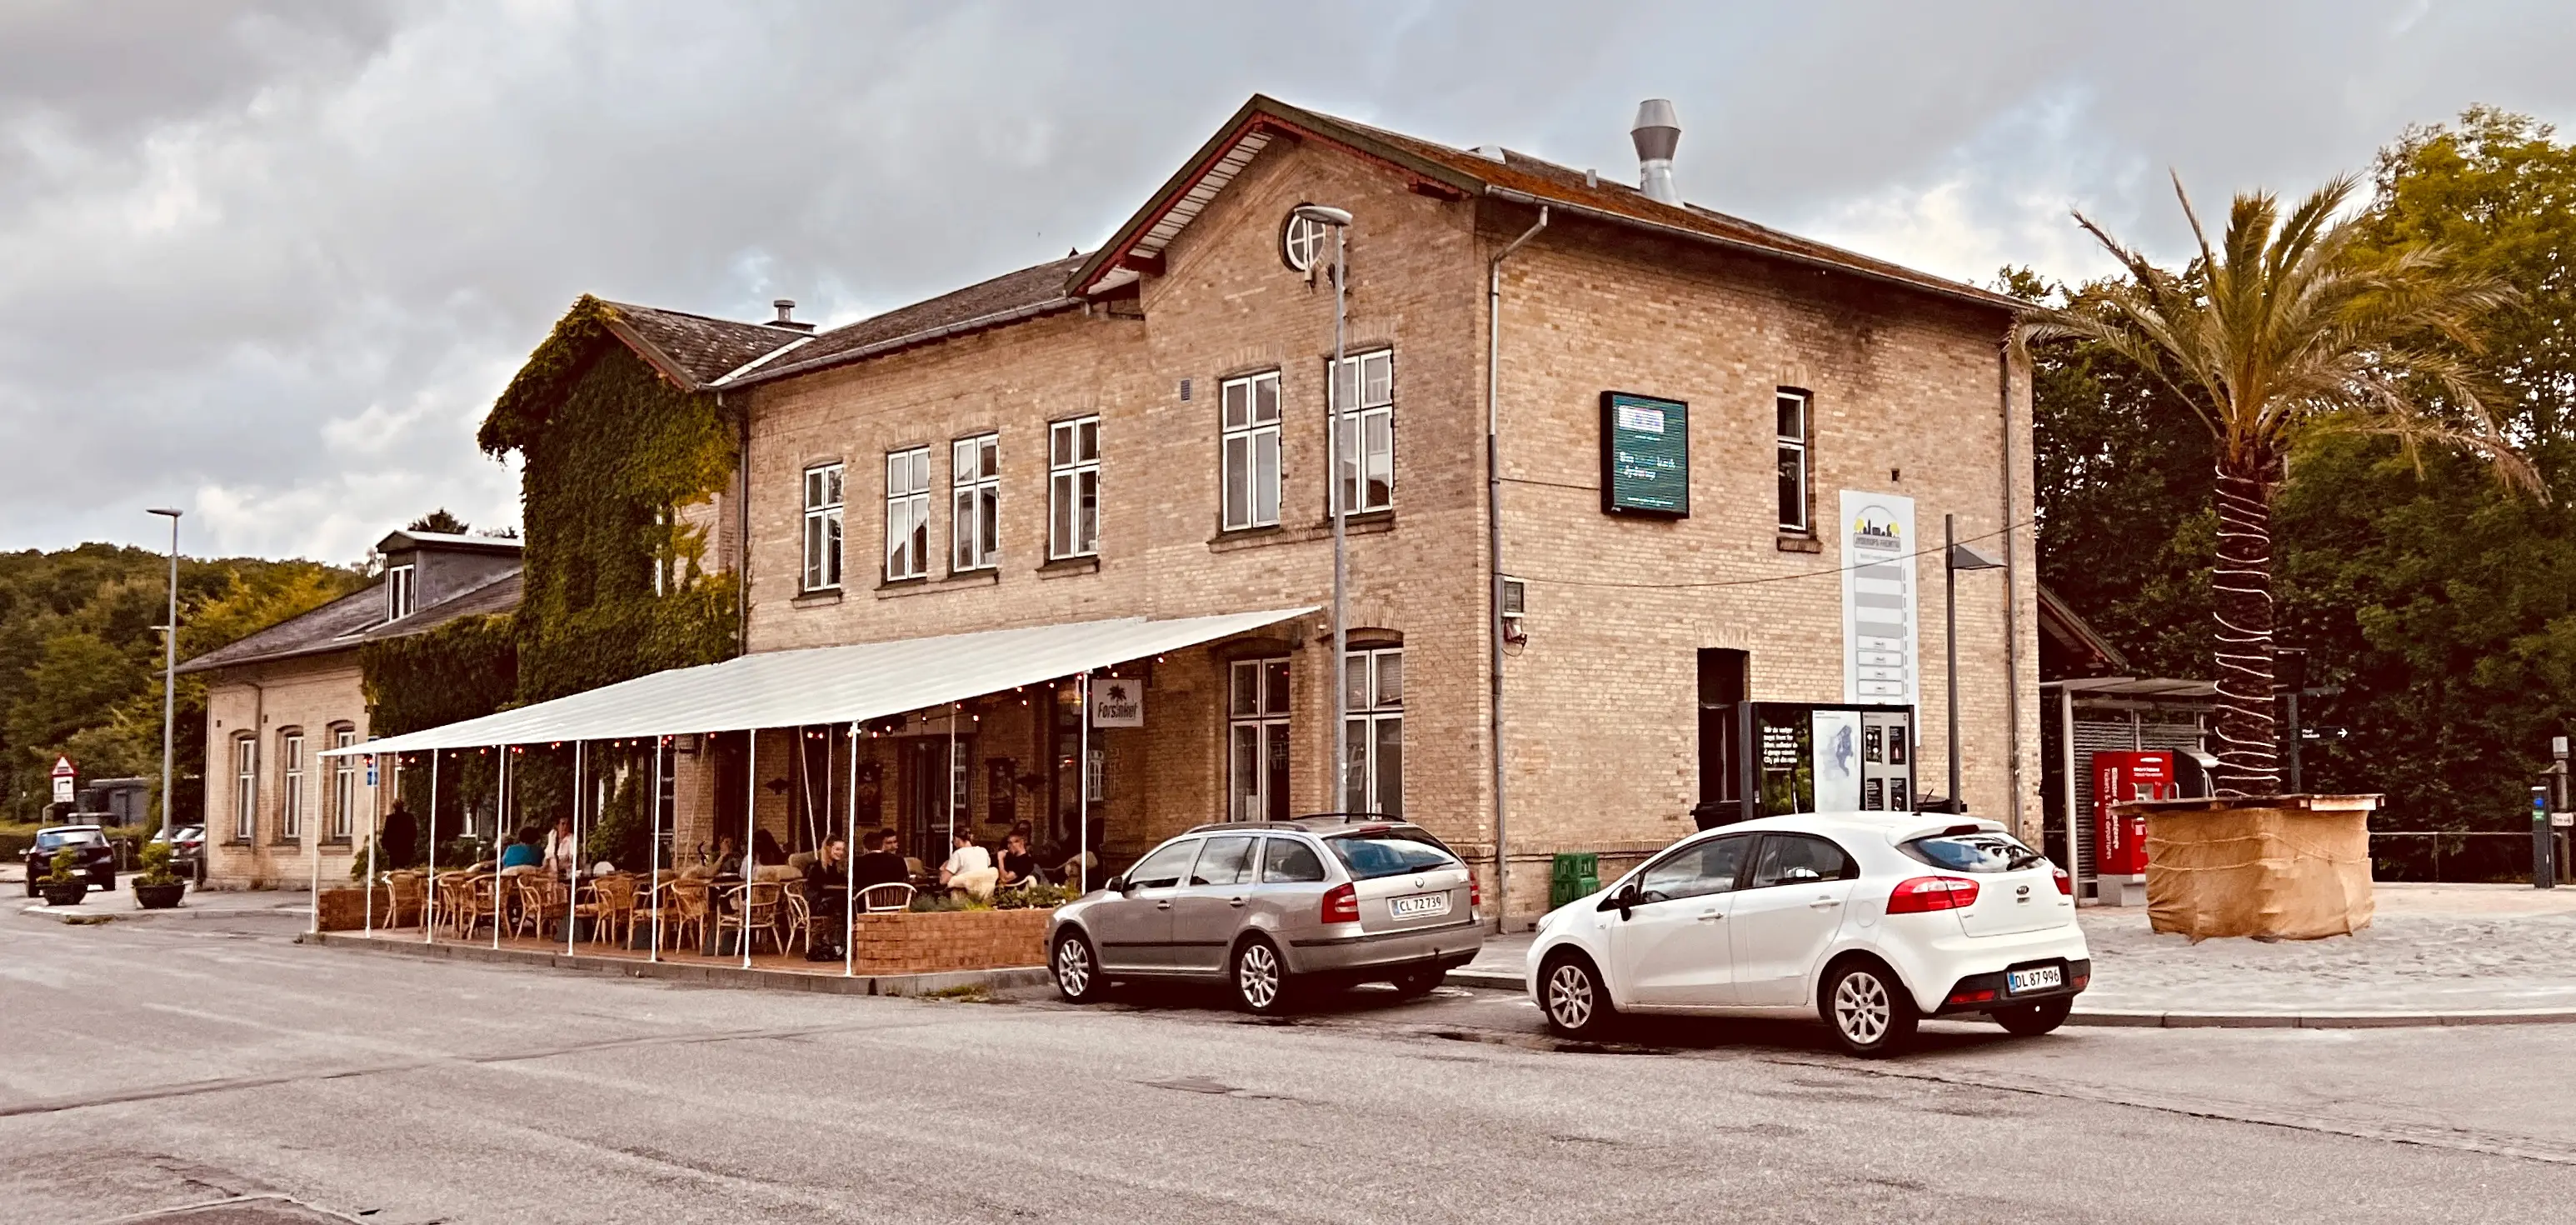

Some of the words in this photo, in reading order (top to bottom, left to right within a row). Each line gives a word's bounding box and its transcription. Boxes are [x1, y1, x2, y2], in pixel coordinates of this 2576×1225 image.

[1097, 702, 1138, 720] Forsinket
[1400, 900, 1411, 912] CL
[1414, 898, 1425, 909] 72
[1425, 896, 1441, 908] 739
[2015, 974, 2029, 988] DL
[2029, 972, 2040, 986] 87
[2043, 969, 2059, 984] 996
